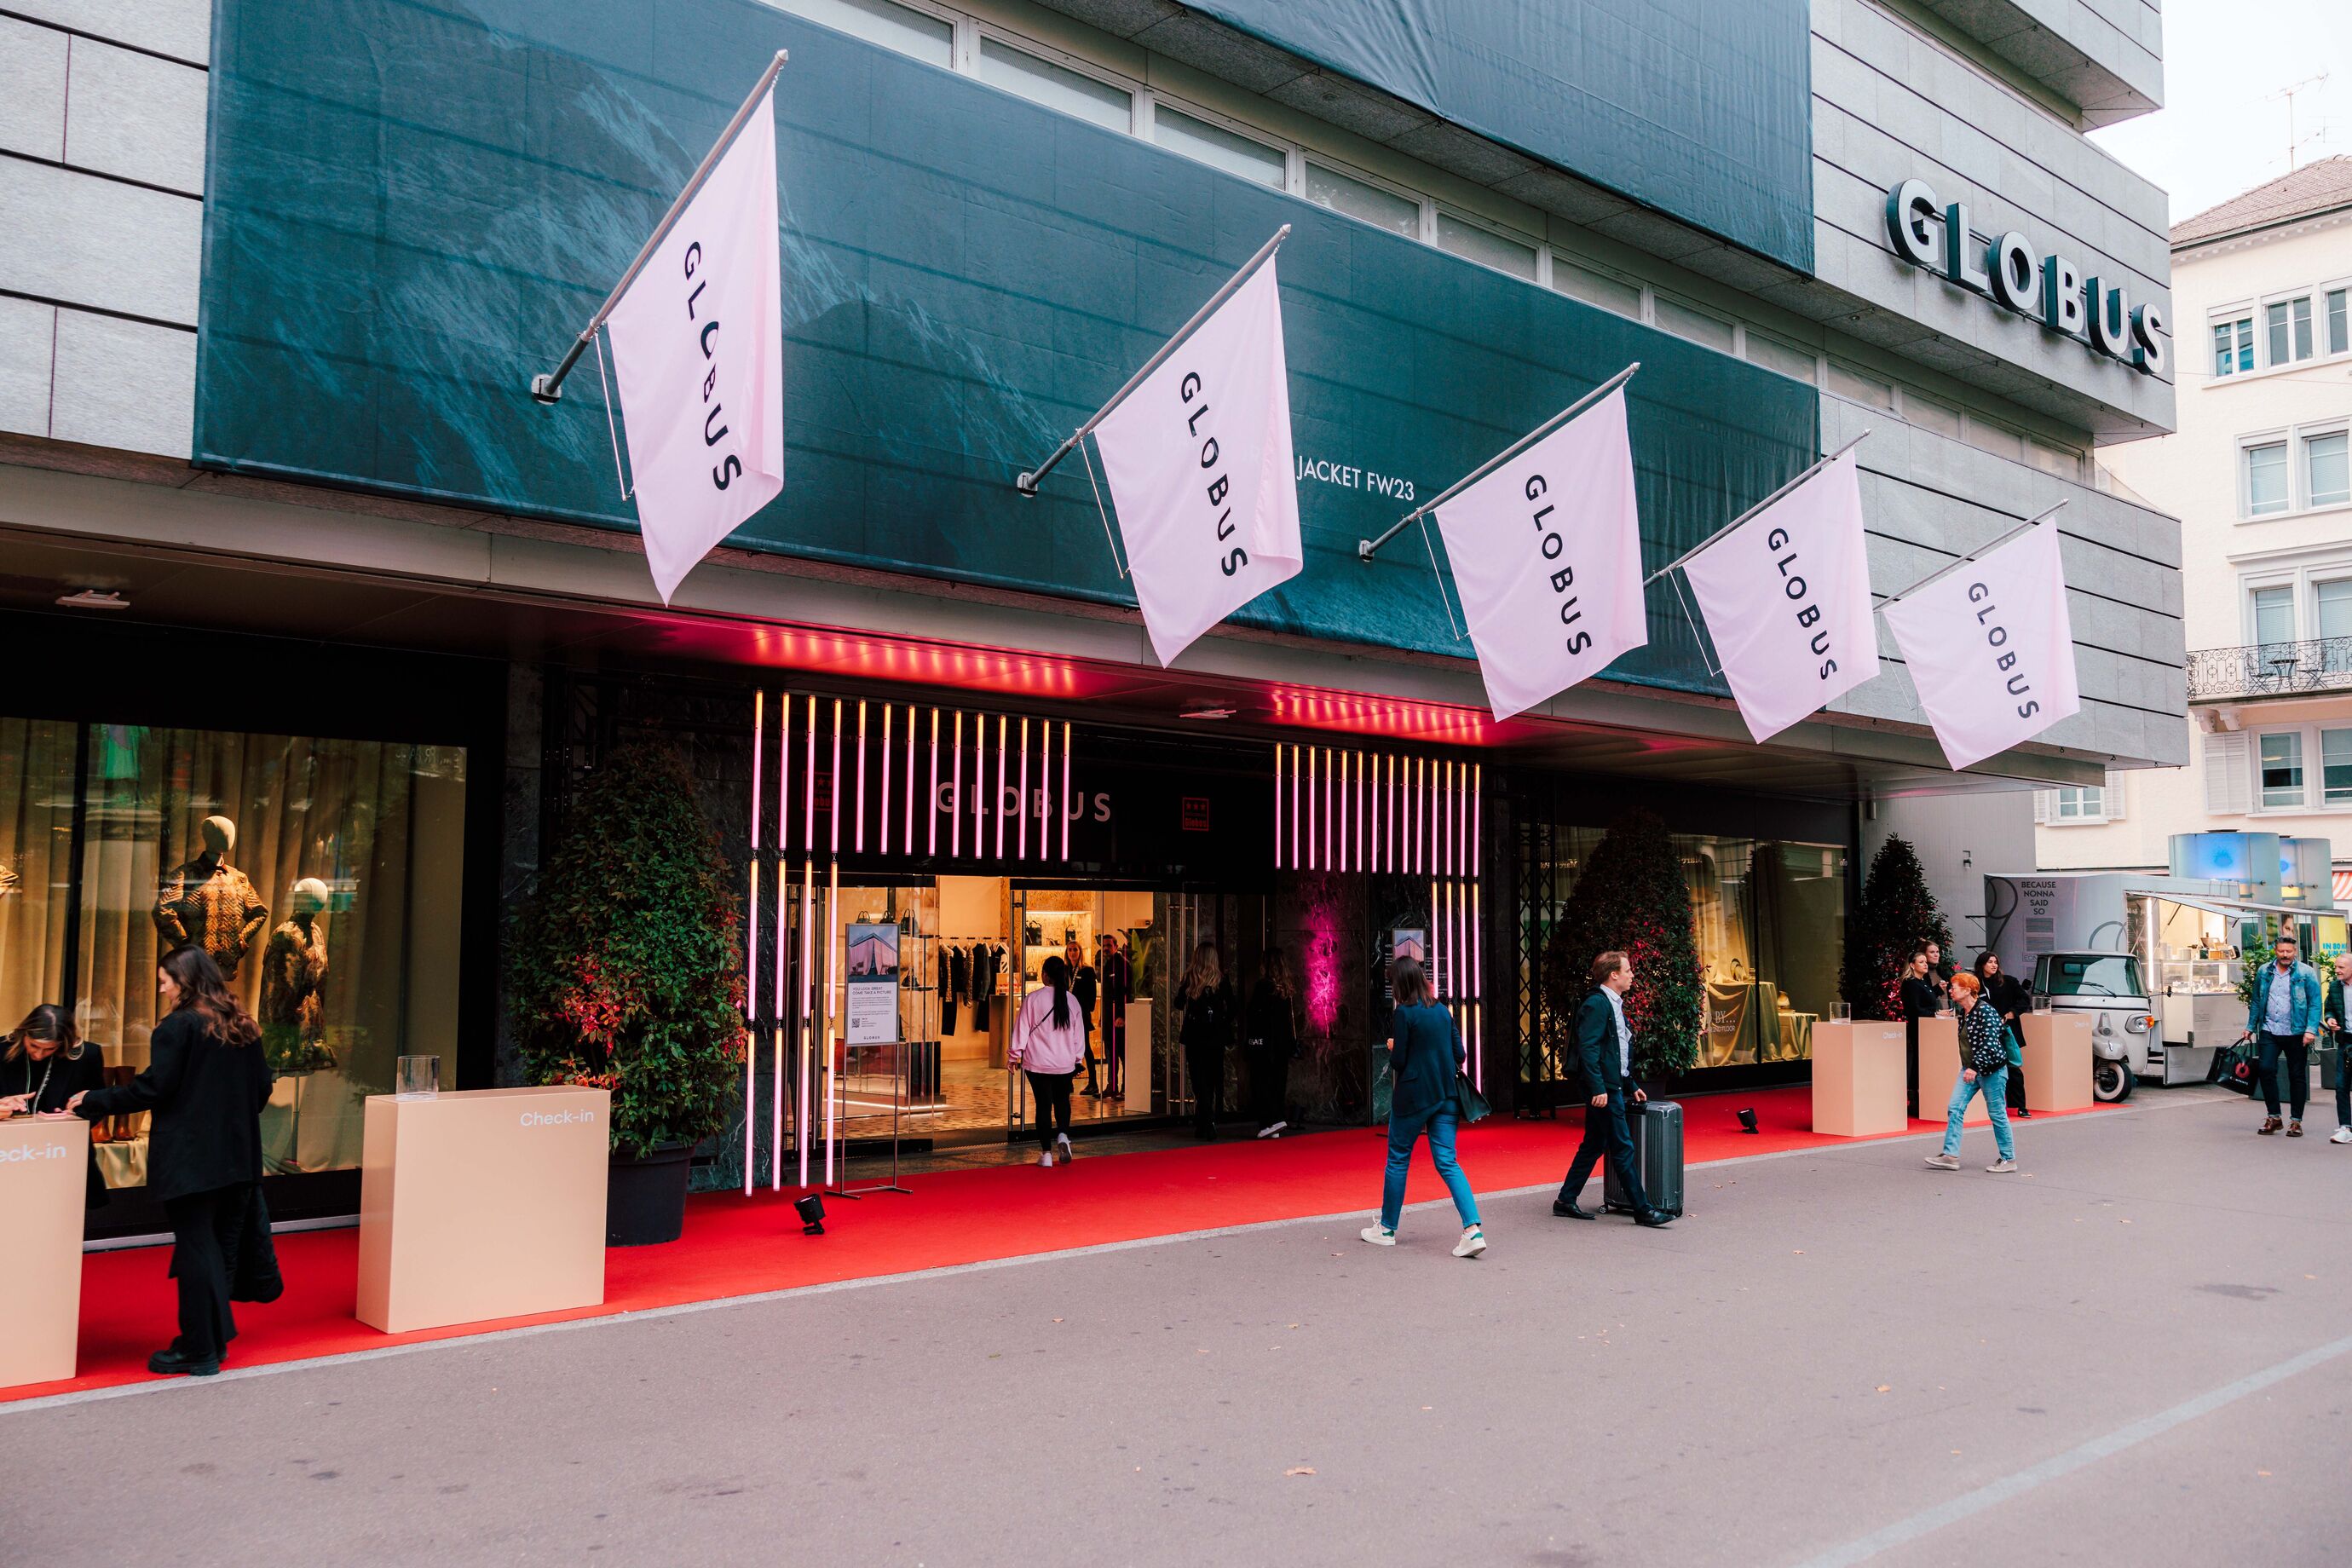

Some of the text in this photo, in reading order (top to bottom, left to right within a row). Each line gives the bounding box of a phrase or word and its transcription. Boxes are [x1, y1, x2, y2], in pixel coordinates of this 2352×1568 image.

[1886, 178, 2165, 376] GLOBUS
[684, 241, 742, 491] GLOBUS
[1180, 372, 1248, 577] GLOBUS
[1296, 455, 1415, 501] JACKET FW23
[1525, 474, 1593, 655] GLOBUS
[1767, 527, 1838, 681] GLOBUS
[1968, 582, 2039, 719] GLOBUS
[936, 781, 1111, 822] GLOBUS
[0, 1143, 67, 1163] eck-in
[519, 1109, 594, 1127] Check-in
